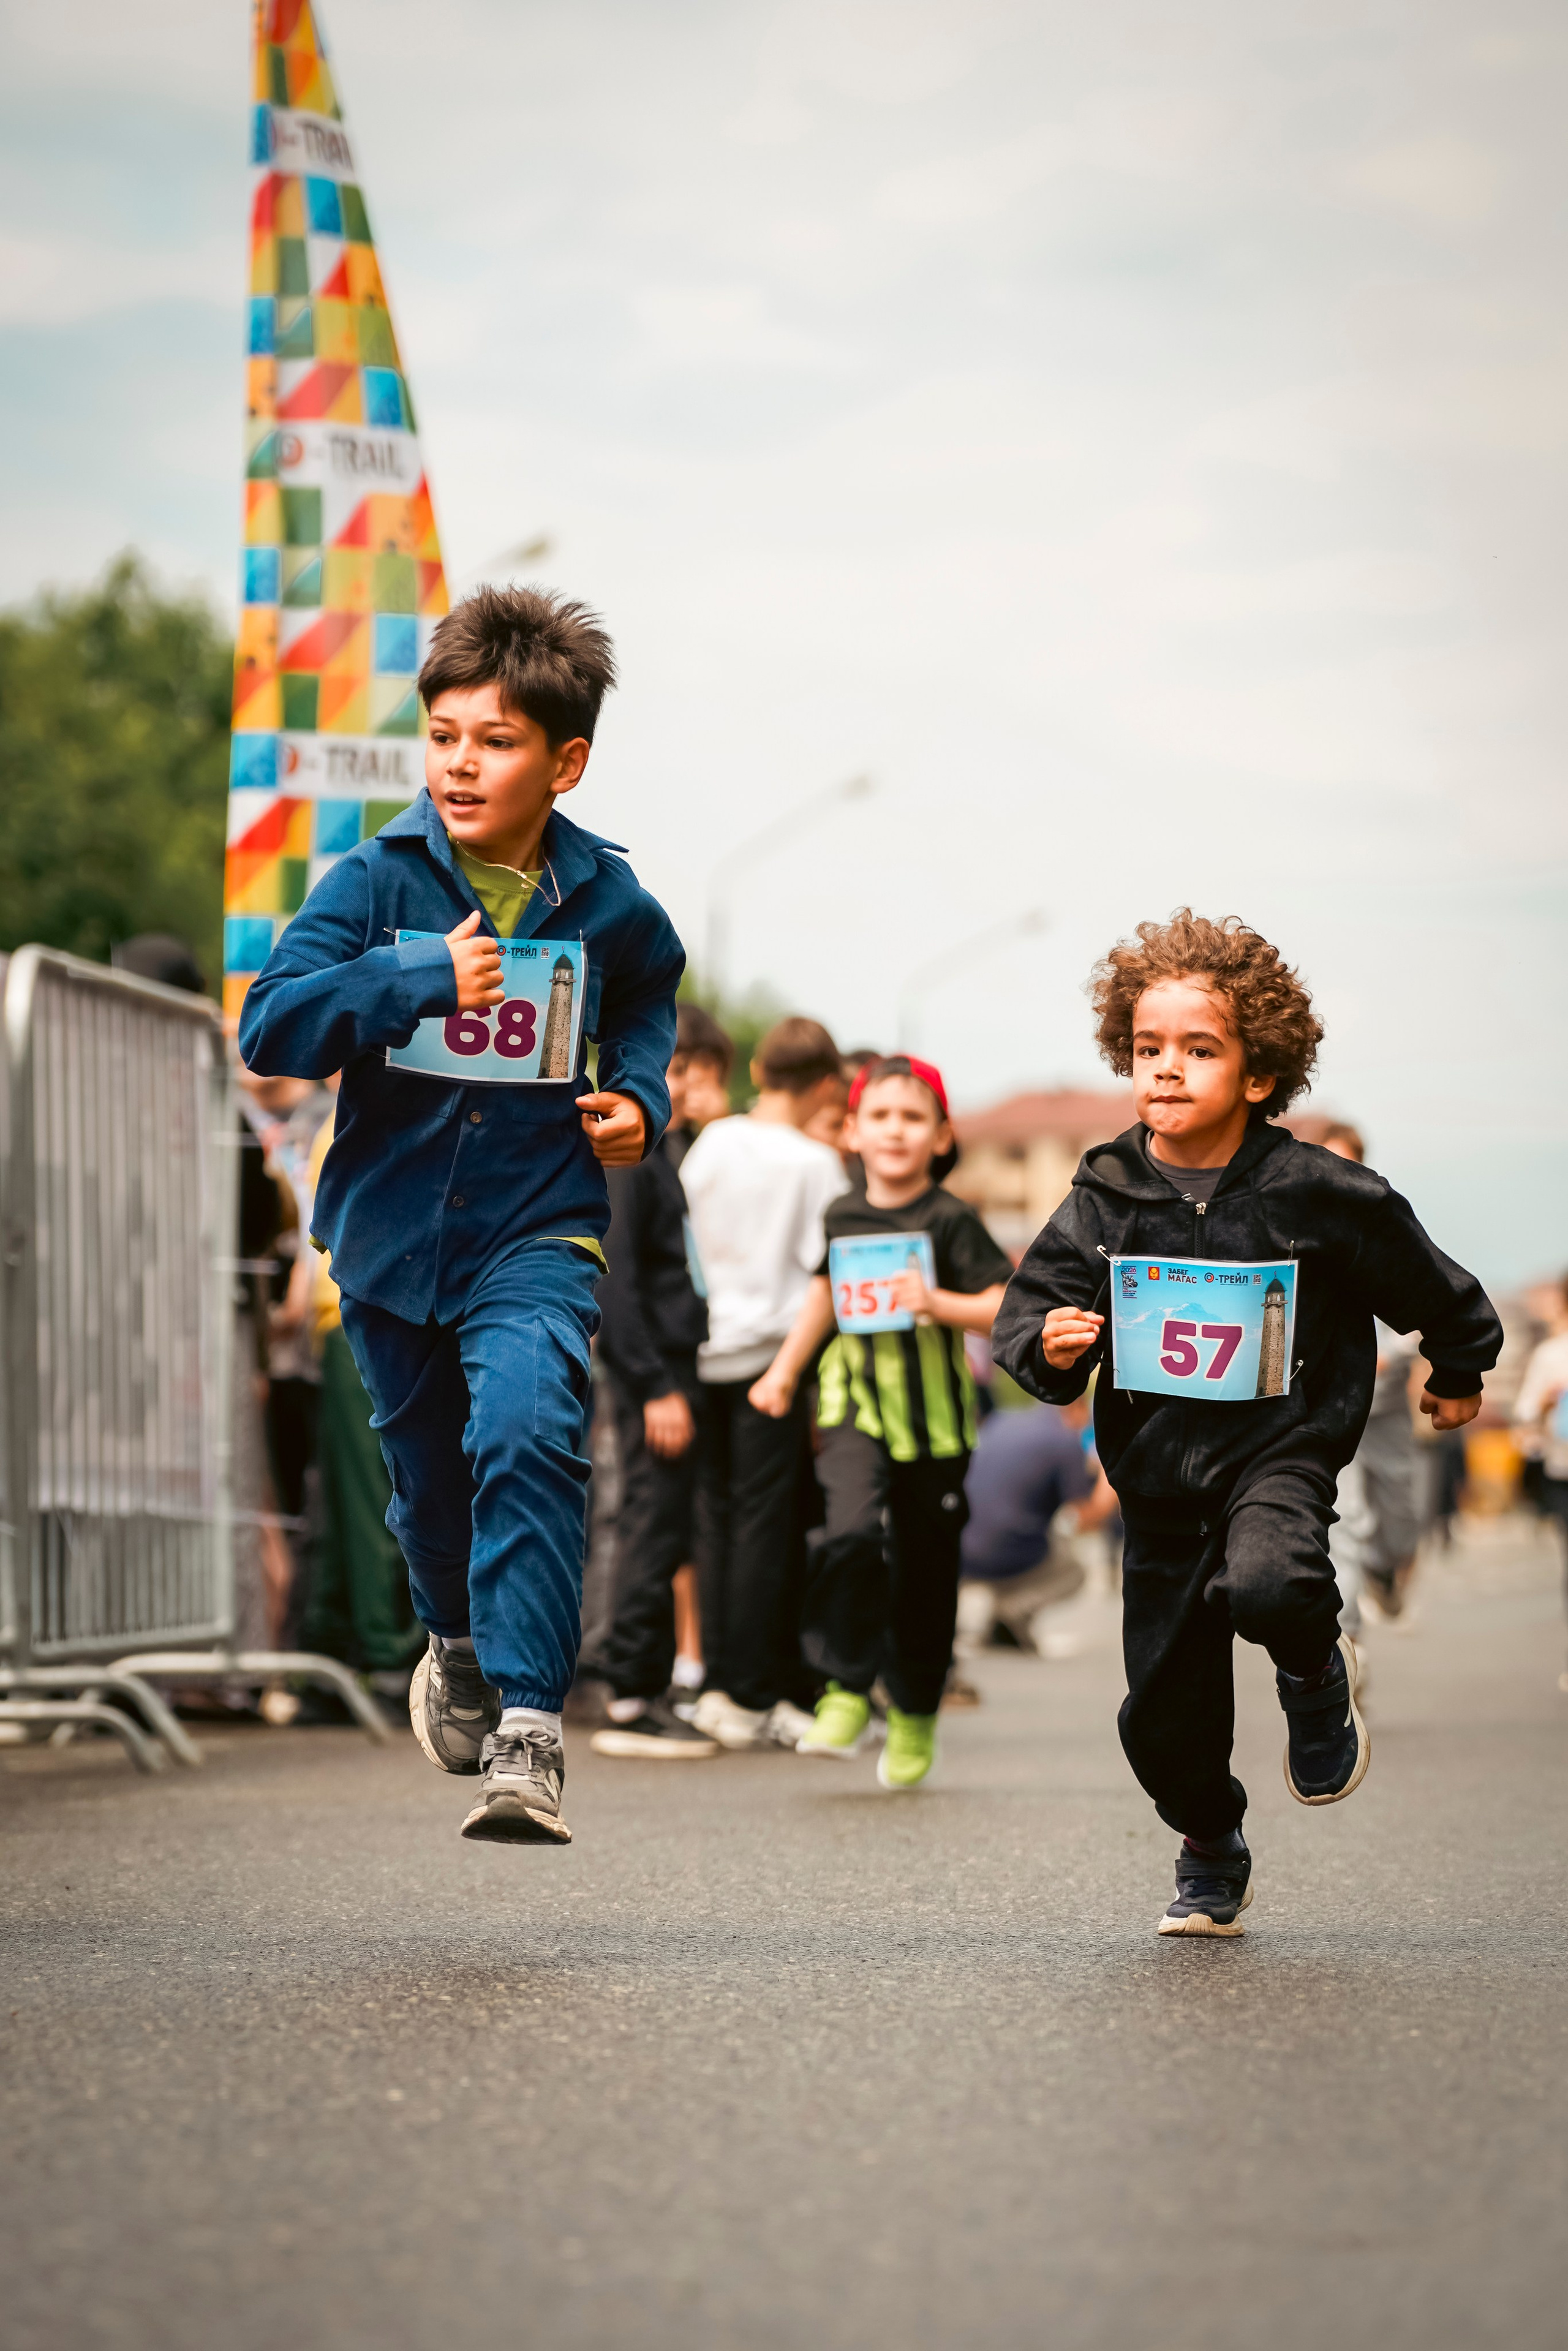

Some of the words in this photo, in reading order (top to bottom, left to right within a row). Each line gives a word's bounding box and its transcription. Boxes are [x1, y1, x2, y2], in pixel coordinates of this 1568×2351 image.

[444, 999, 537, 1059] 68
[1167, 1274, 1197, 1284] МАГАС
[1159, 1320, 1242, 1379] 57
